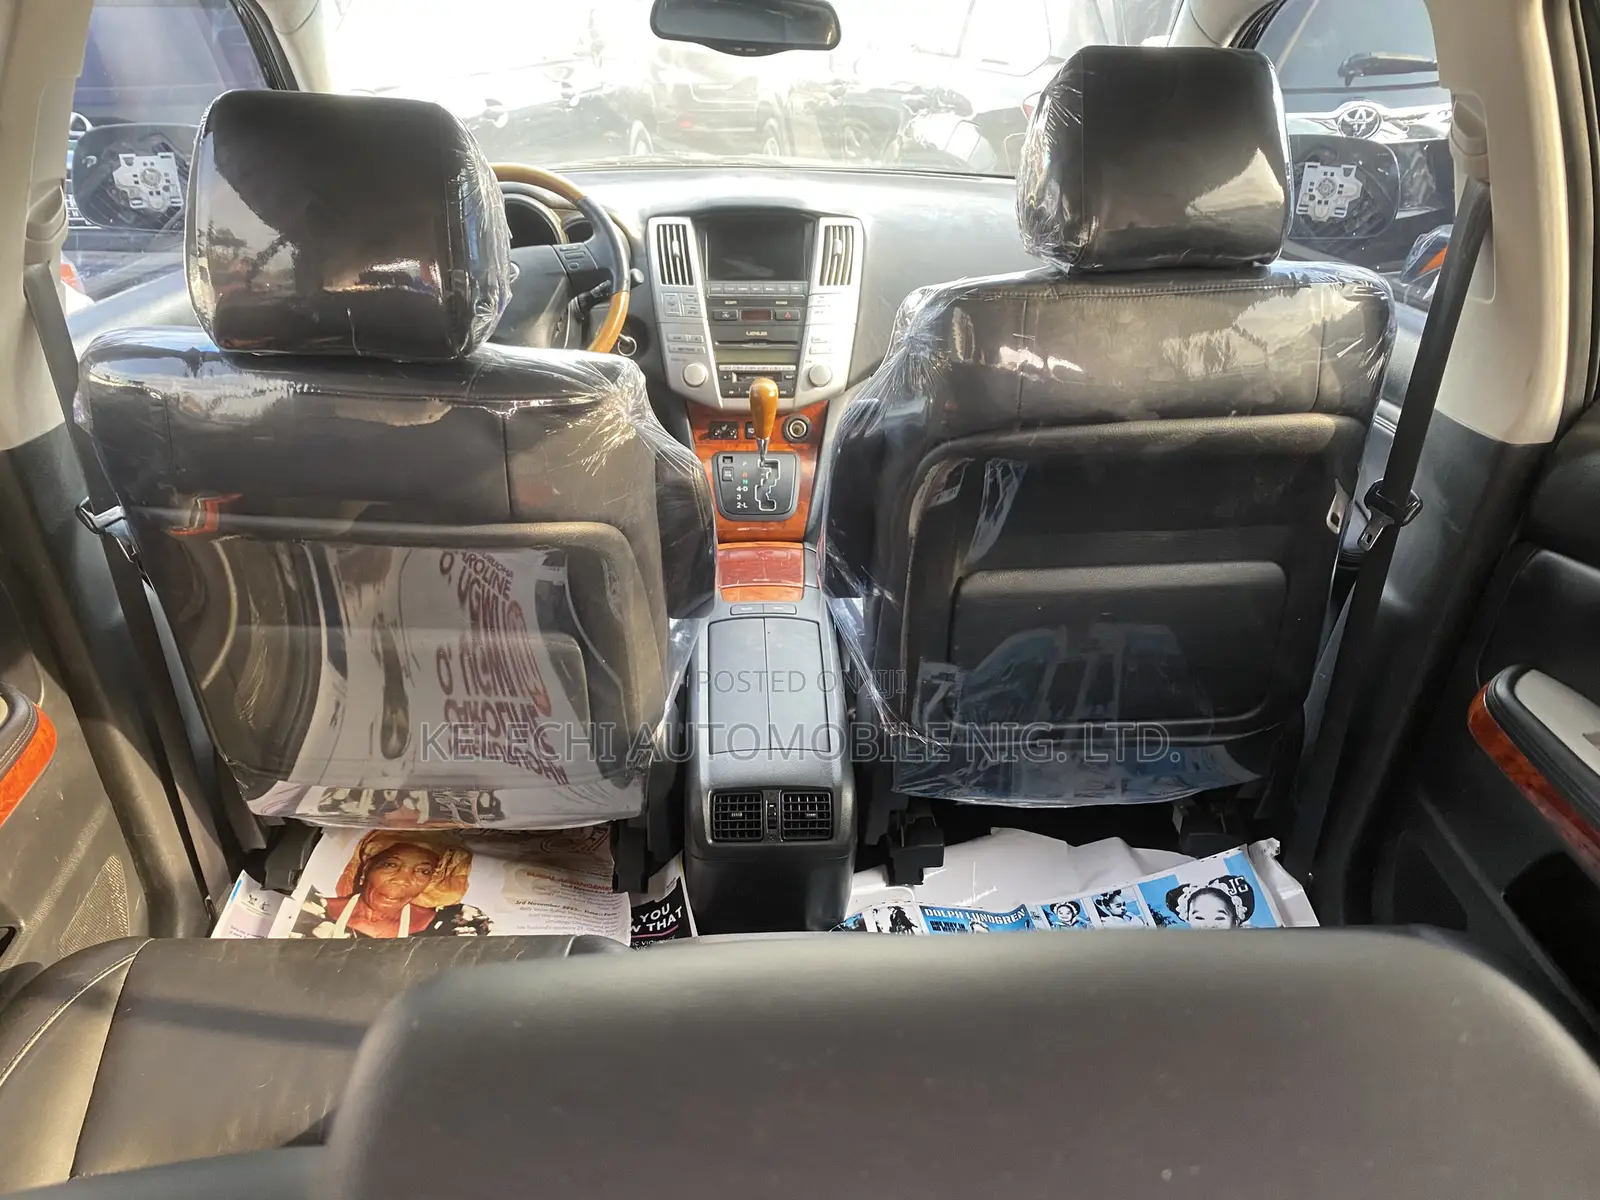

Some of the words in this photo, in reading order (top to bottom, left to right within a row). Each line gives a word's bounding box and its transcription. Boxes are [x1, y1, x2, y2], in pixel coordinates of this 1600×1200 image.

[640, 903, 670, 923] YOU
[646, 906, 683, 932] THAT
[924, 908, 964, 920] DOLPH
[966, 908, 1026, 925] LUNDGREN
